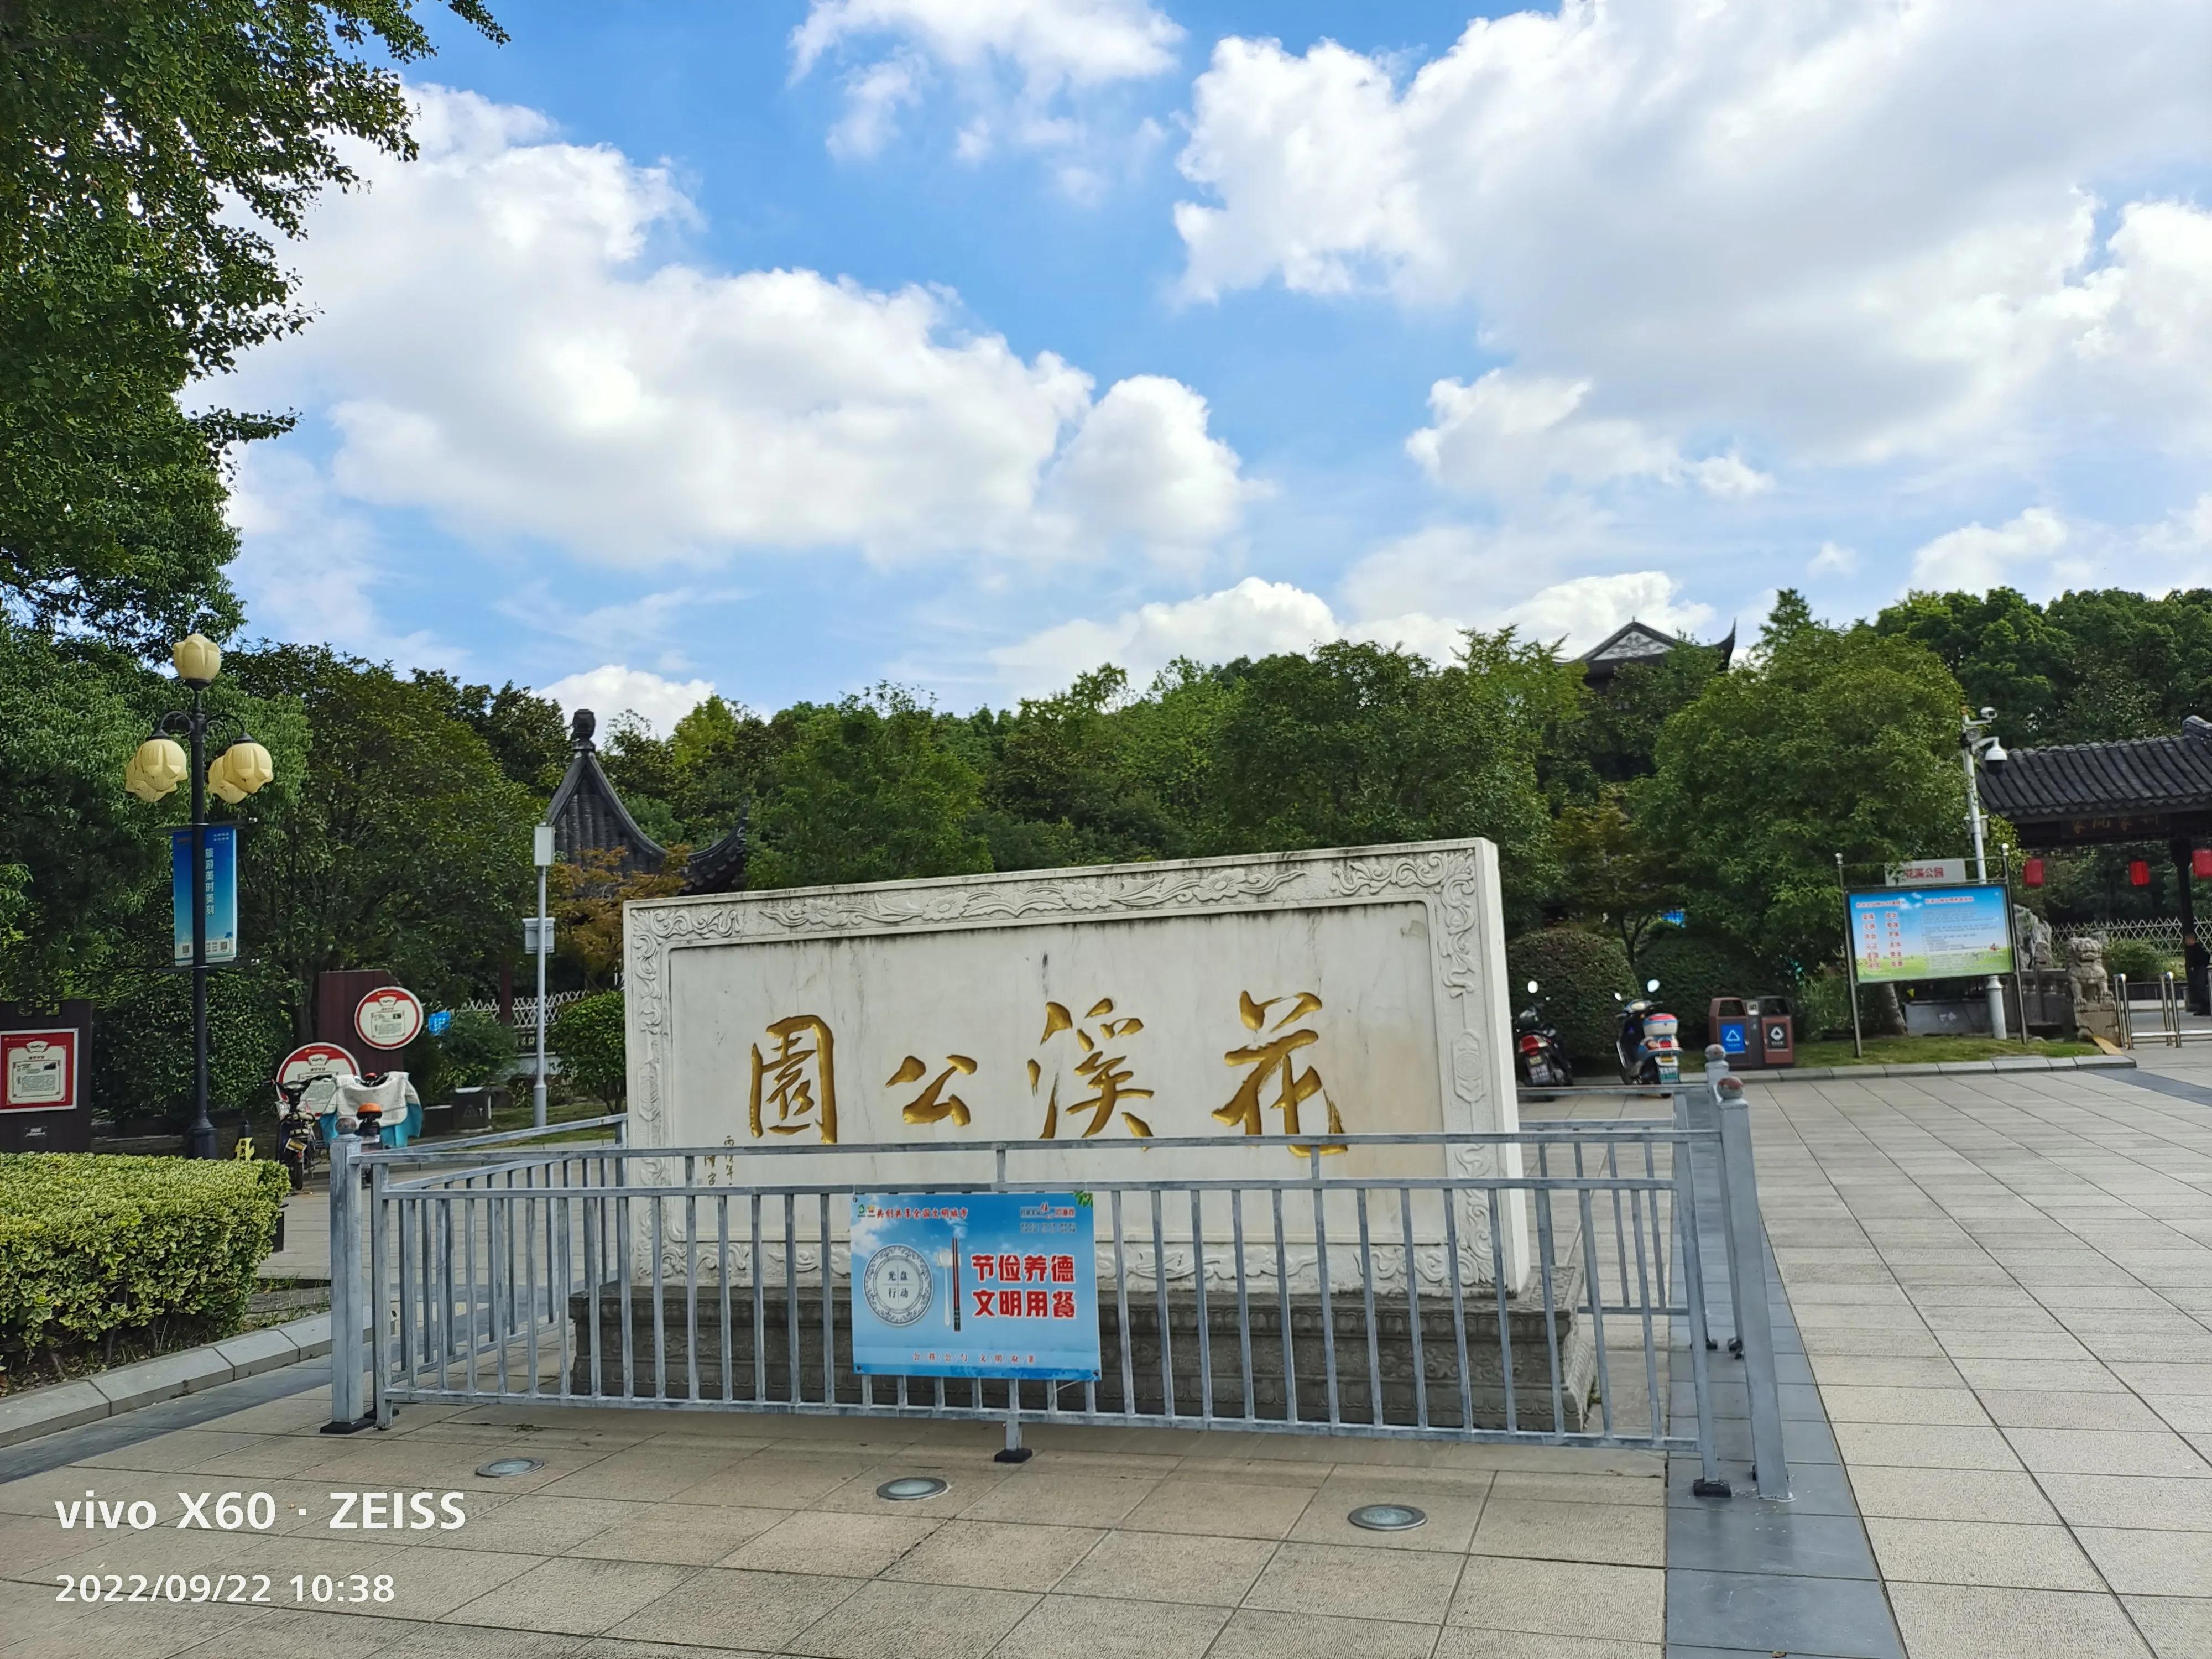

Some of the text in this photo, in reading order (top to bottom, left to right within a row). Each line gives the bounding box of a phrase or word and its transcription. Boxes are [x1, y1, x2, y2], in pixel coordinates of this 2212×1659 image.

[972, 1254, 1075, 1283] 节俭养德
[972, 1290, 1077, 1319] 文明用餐
